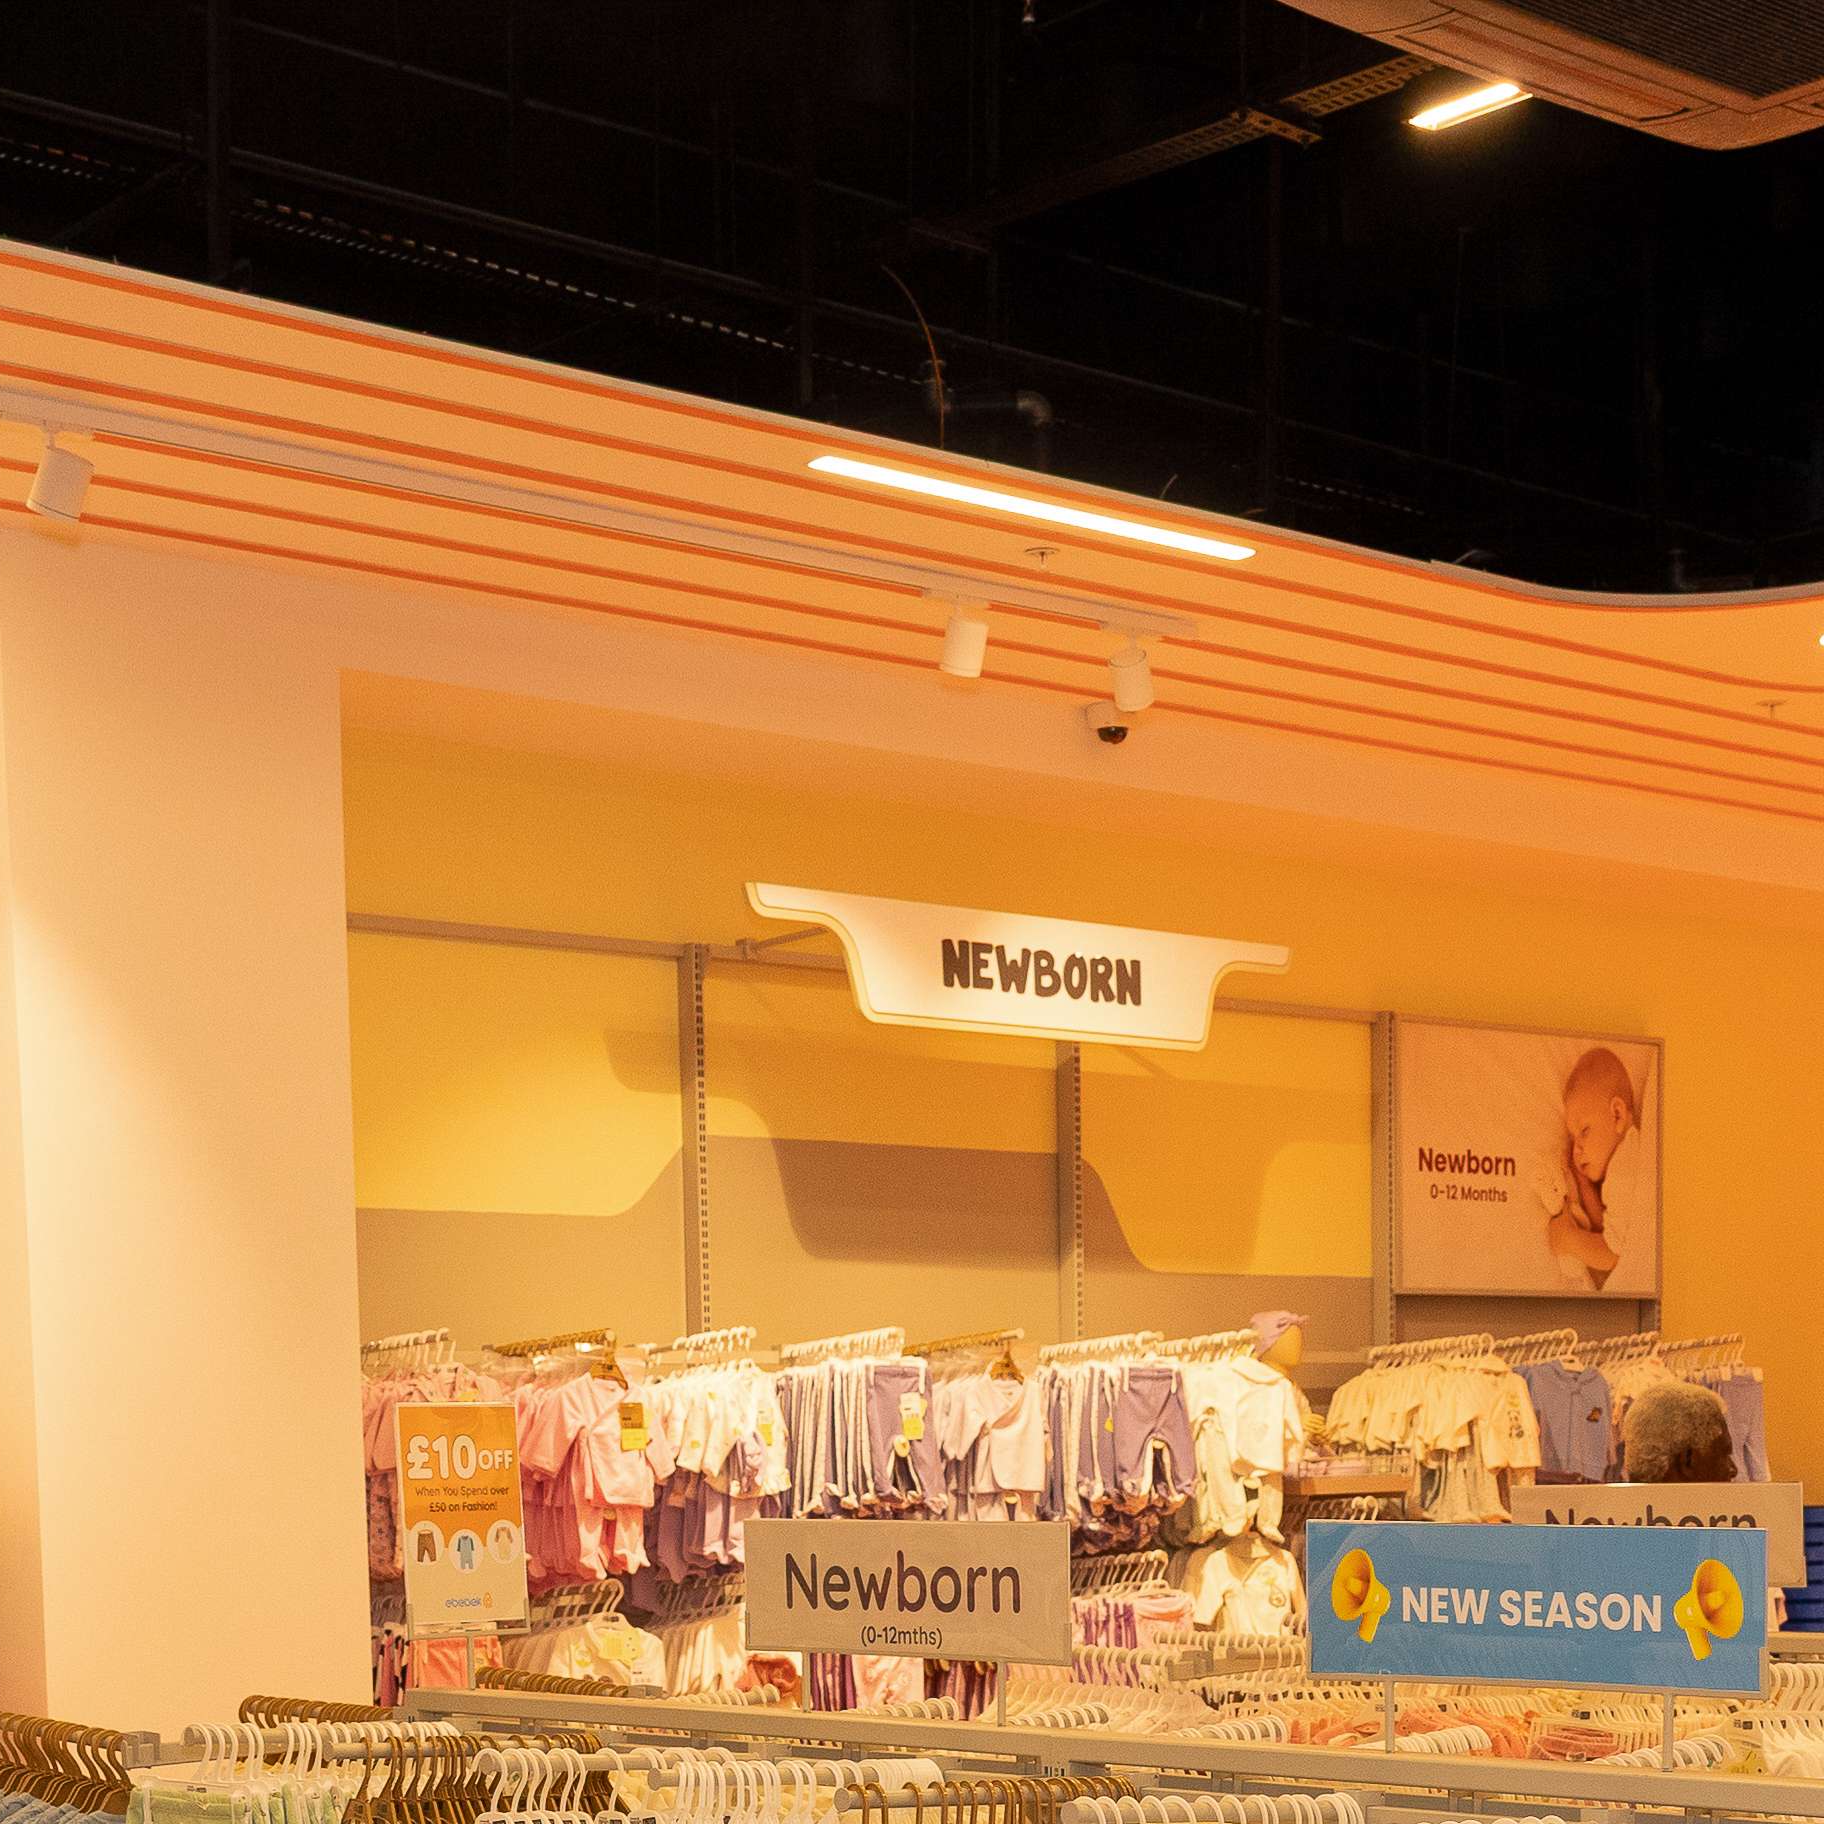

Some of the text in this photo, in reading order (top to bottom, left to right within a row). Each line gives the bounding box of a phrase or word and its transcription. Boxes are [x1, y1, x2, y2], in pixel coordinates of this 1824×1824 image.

[941, 938, 1142, 1006] NEWBORN
[1418, 1147, 1516, 1176] Newborn
[1430, 1183, 1508, 1202] 0-12 Months
[406, 1434, 513, 1480] £10 OFF
[415, 1486, 509, 1498] When You Spend over
[429, 1501, 497, 1512] £50 on Fashion!
[785, 1550, 1021, 1614] Newborn
[1402, 1585, 1662, 1633] NEW SEASON
[860, 1625, 943, 1649] (0-12mths)
